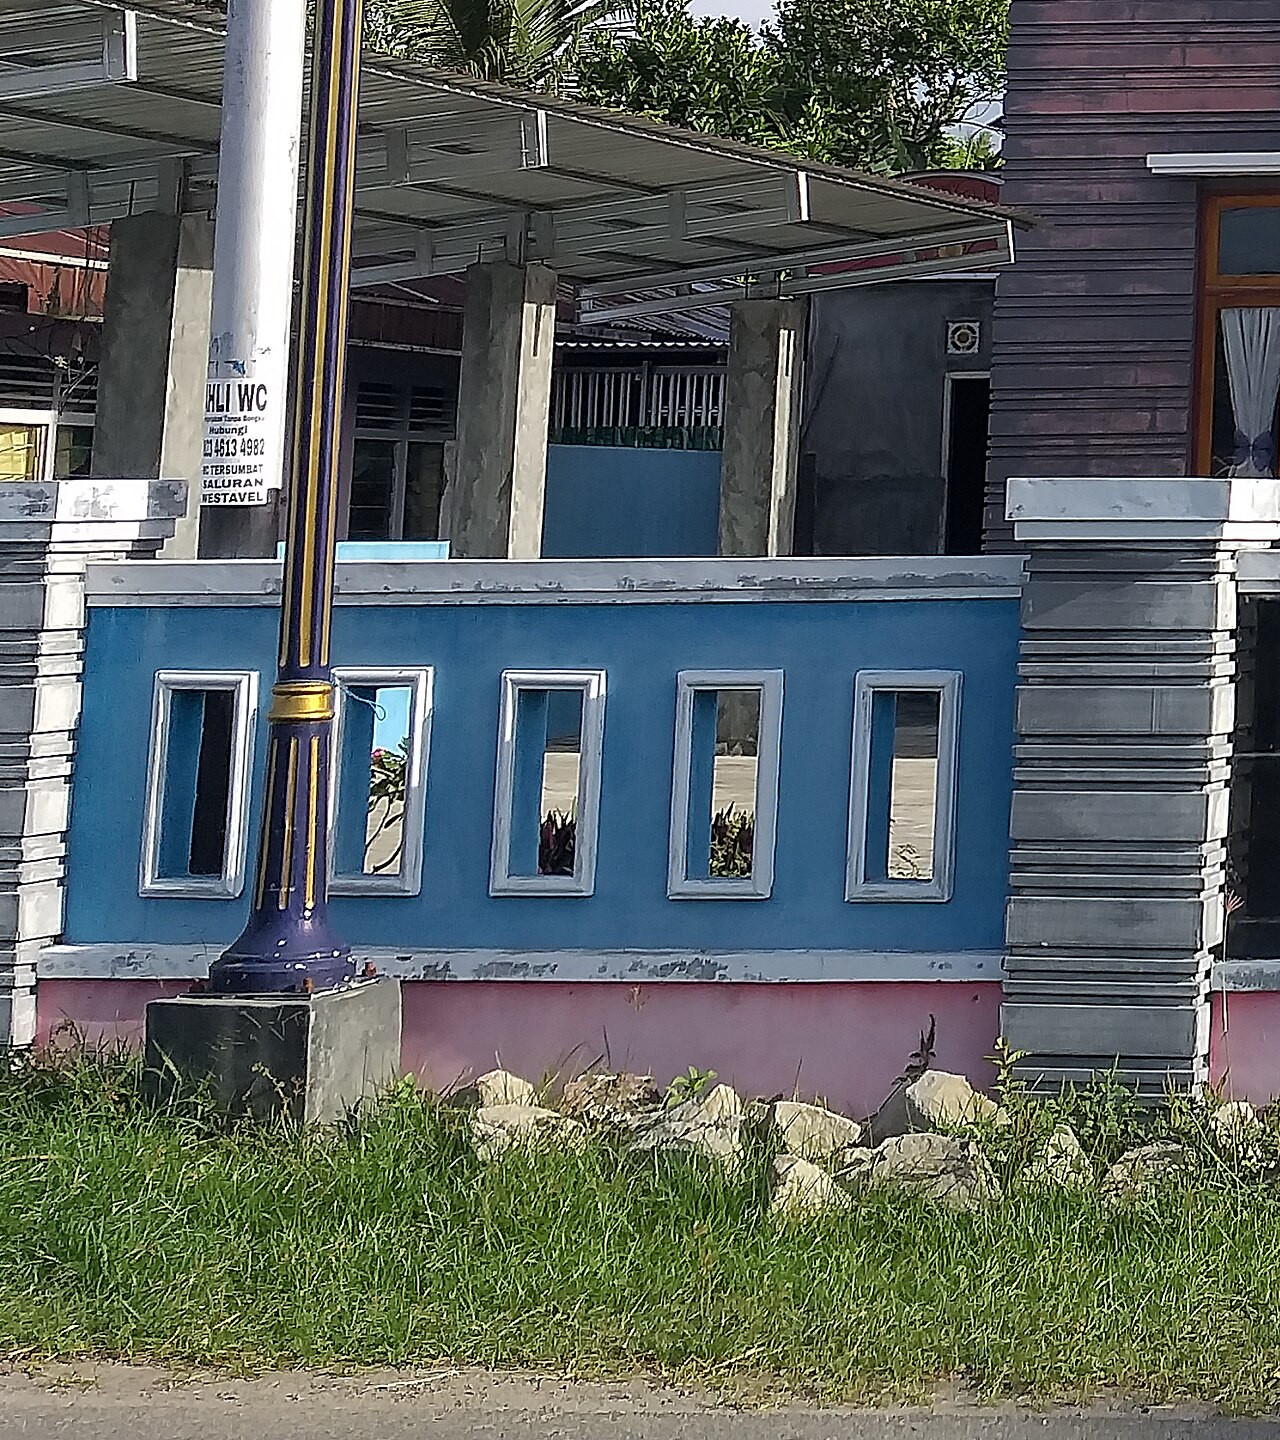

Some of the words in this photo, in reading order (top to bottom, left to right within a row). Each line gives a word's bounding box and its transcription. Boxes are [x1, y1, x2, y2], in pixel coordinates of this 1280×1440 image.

[205, 384, 230, 412] HLI
[237, 384, 267, 411] WC
[209, 425, 248, 436] Hubungi
[214, 438, 237, 457] 4613
[240, 438, 265, 456] 4982
[210, 464, 263, 475] TERSUMBAT
[203, 478, 263, 489] SALURAN
